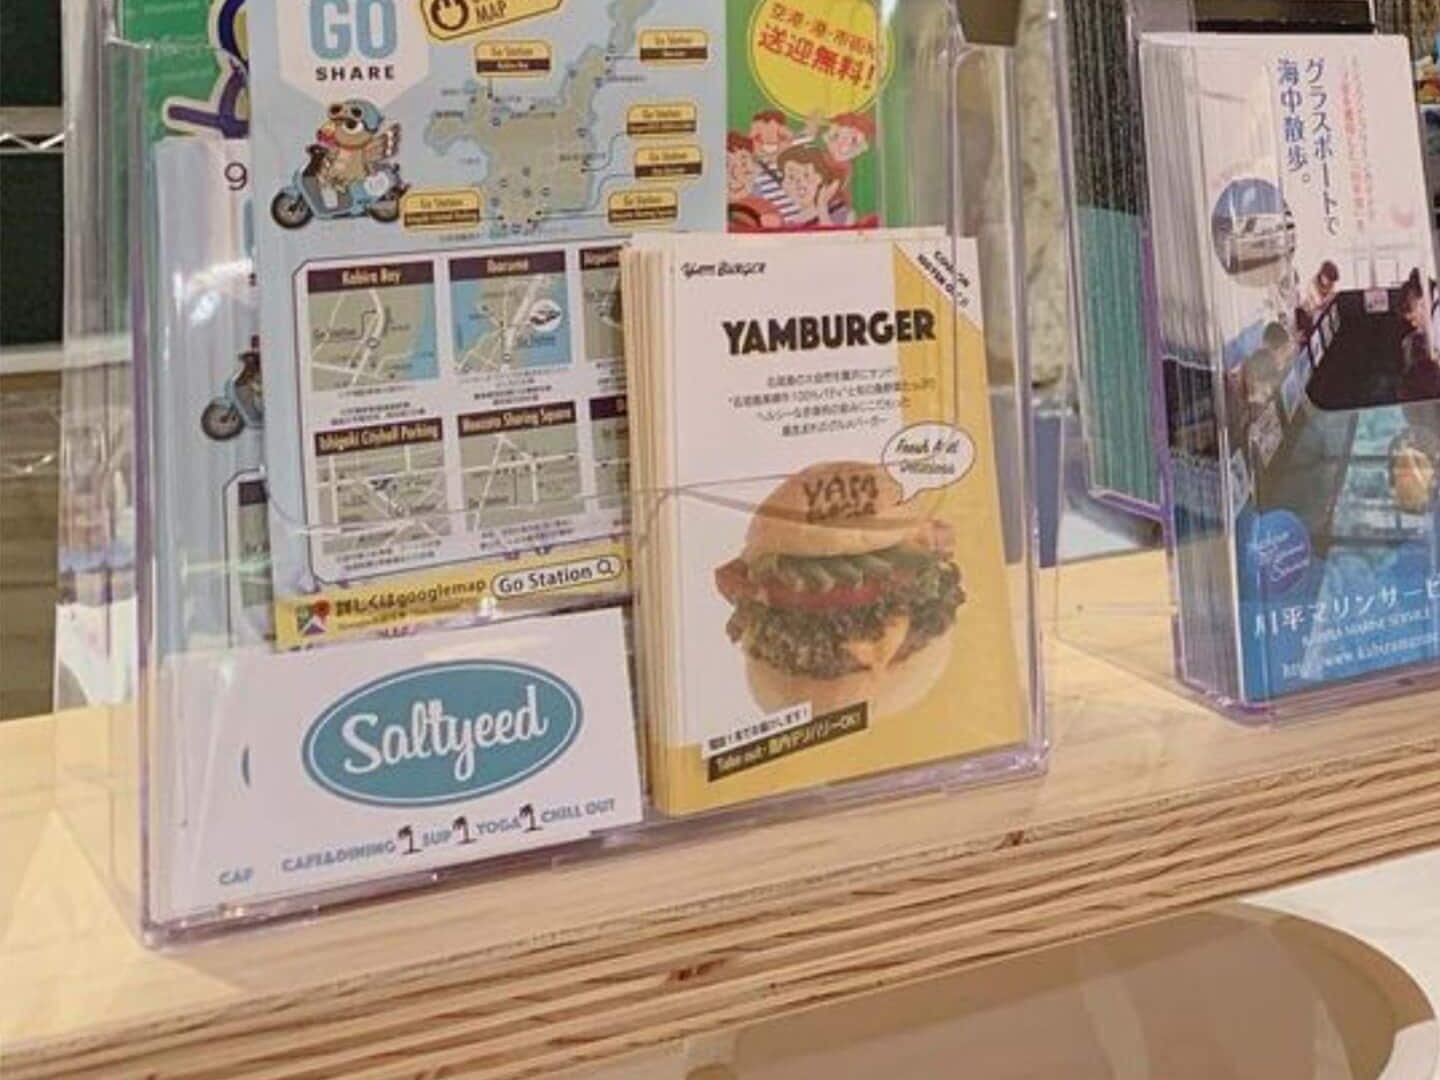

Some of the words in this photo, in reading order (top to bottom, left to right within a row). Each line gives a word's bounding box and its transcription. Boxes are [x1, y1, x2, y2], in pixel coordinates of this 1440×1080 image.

[475, 1, 507, 24] MAP
[315, 66, 396, 82] SHARE
[1305, 58, 1340, 236] グラスボートで
[723, 309, 936, 356] YAMBURGER
[498, 575, 524, 595] Go
[527, 565, 593, 590] Station
[341, 684, 550, 783] Saltyeed
[422, 829, 453, 847] SUP
[475, 816, 522, 838] YOGA
[540, 804, 583, 824] CHILL
[585, 797, 617, 817] OUT
